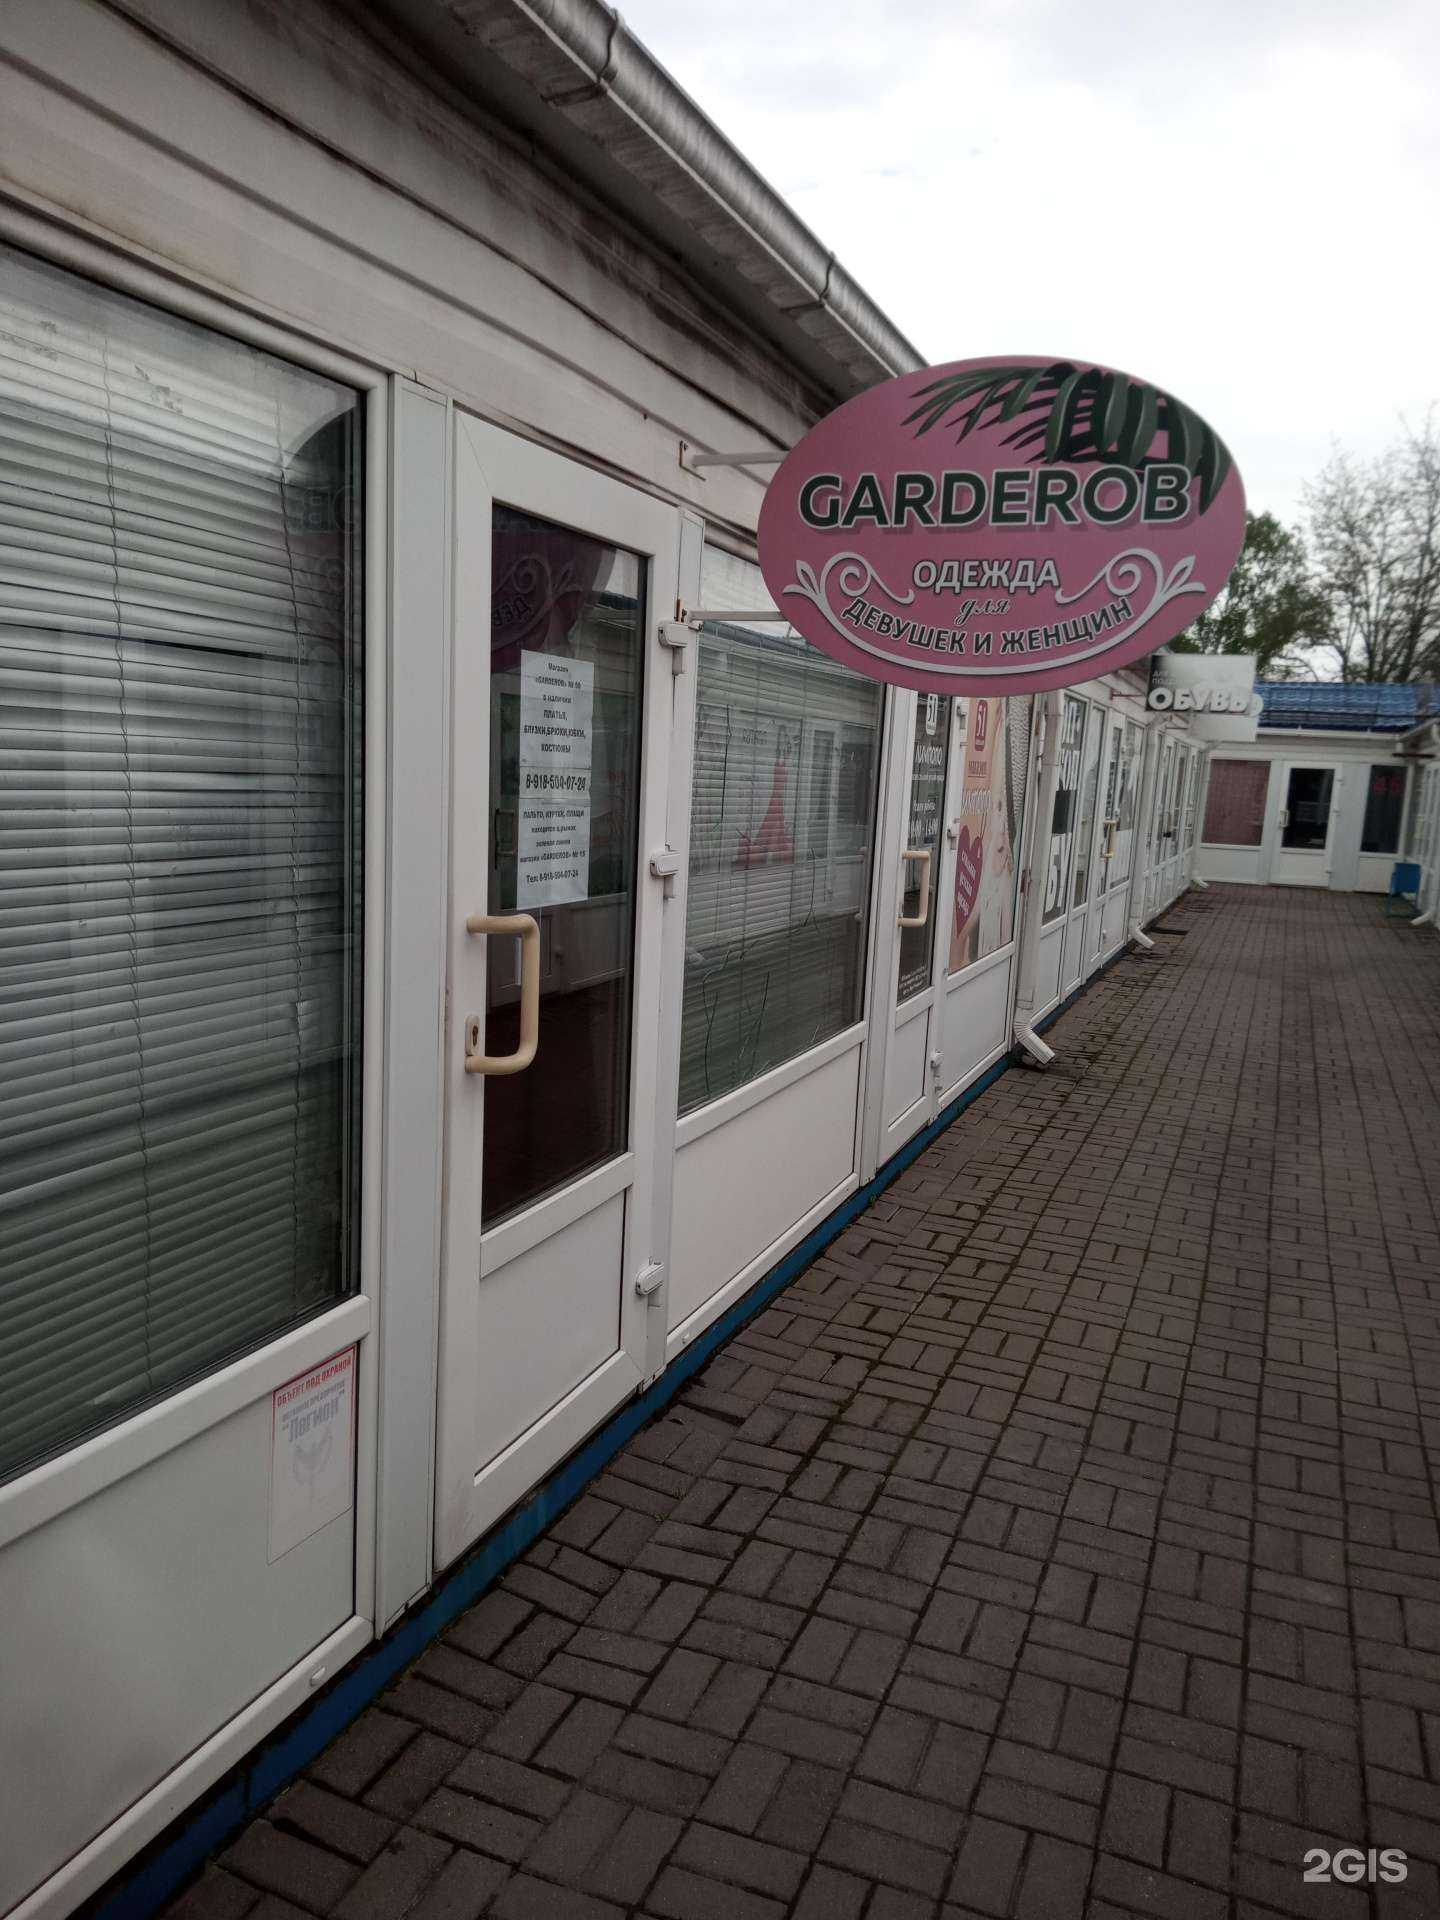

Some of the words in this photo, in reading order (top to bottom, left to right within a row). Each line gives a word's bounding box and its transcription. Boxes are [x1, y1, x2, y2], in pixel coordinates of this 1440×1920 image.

[799, 464, 1192, 530] GARDEROB
[912, 559, 1061, 594] ОДЕЖДА
[841, 598, 966, 654] ДЕВУШЕК
[973, 633, 993, 656] И
[1000, 597, 1134, 656] ЖЕНЩИН
[954, 597, 1010, 627] для
[1148, 687, 1248, 711] ОБУВЬ
